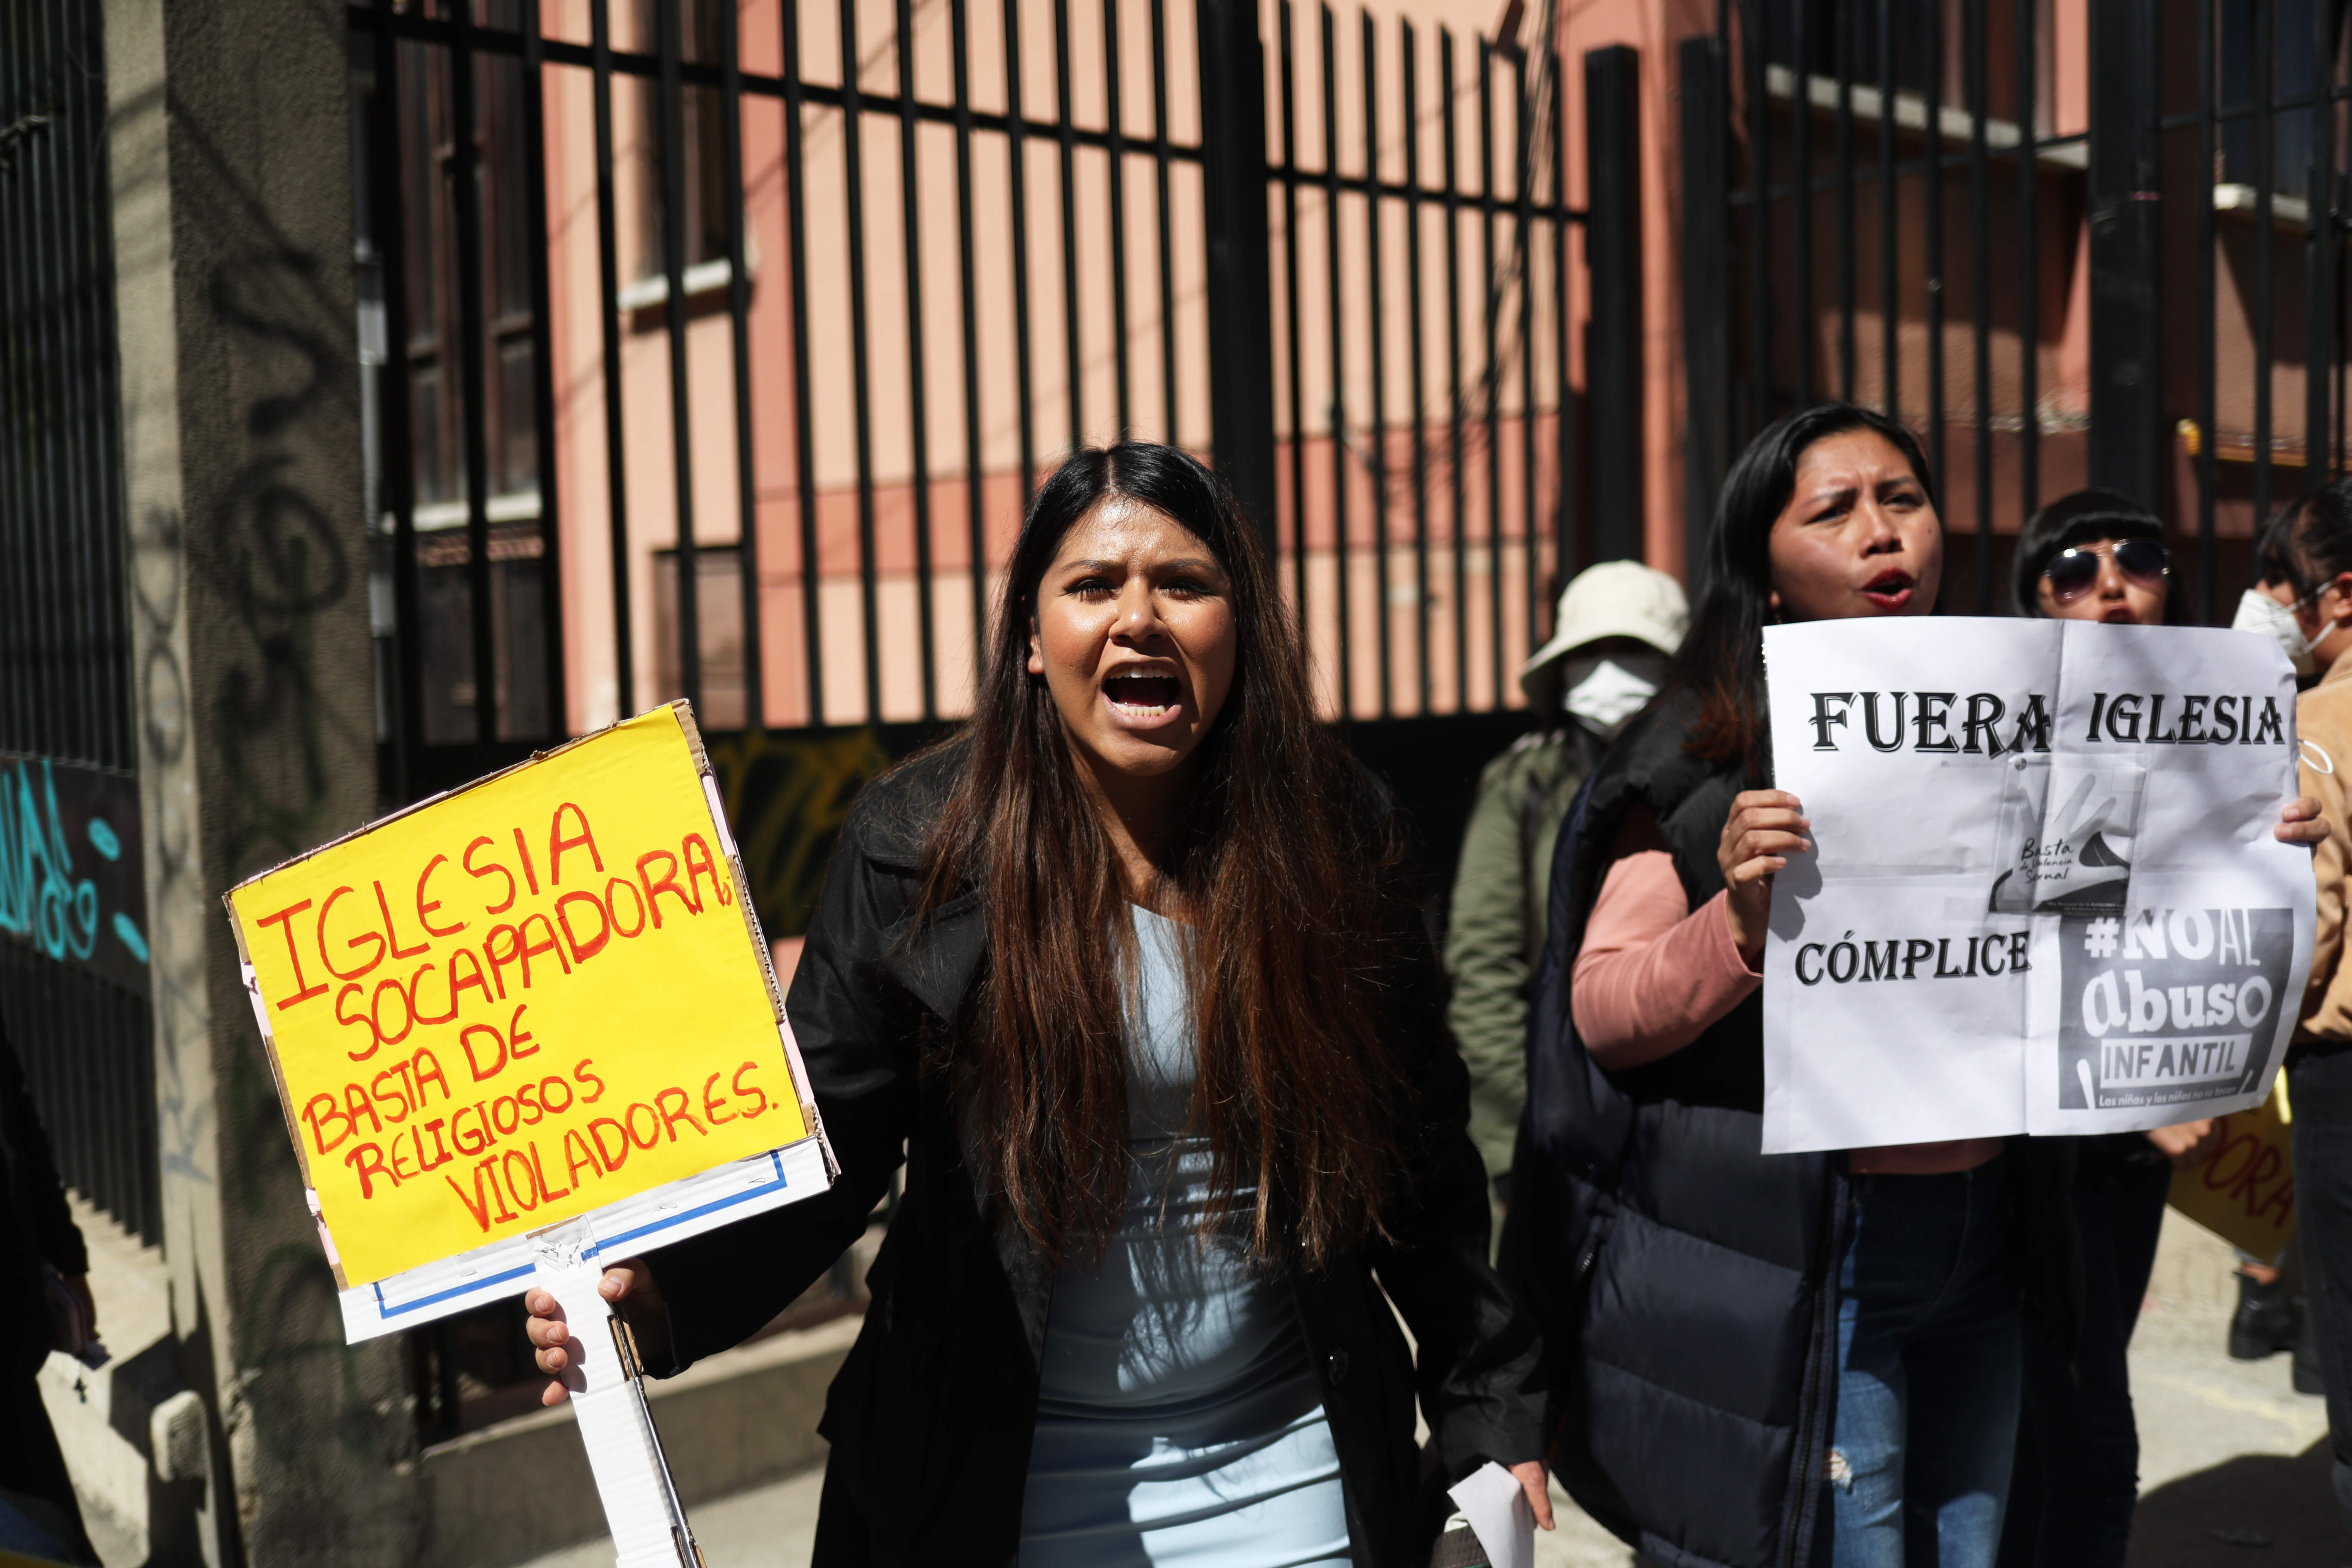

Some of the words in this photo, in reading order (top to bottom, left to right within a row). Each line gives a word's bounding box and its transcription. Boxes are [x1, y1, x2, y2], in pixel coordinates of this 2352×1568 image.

[1809, 692, 2052, 760] FUERA
[2086, 692, 2286, 745] IGLESIA
[2021, 837, 2074, 861] Basta
[257, 802, 603, 1011] IGLESIA
[2219, 907, 2260, 966] AL
[1795, 930, 2033, 986] CÓMPLICE
[2082, 968, 2273, 1038] abuso
[302, 1047, 450, 1155] BASTA
[460, 1004, 540, 1082] DE
[2104, 1041, 2236, 1080] INFANTIL
[345, 1059, 604, 1199] RELIGIOSOS
[2099, 1094, 2116, 1107] Las
[2118, 1093, 2144, 1106] niñas
[2146, 1095, 2152, 1108] y
[2154, 1091, 2167, 1103] los
[446, 1062, 778, 1232] VIOLADORES.
